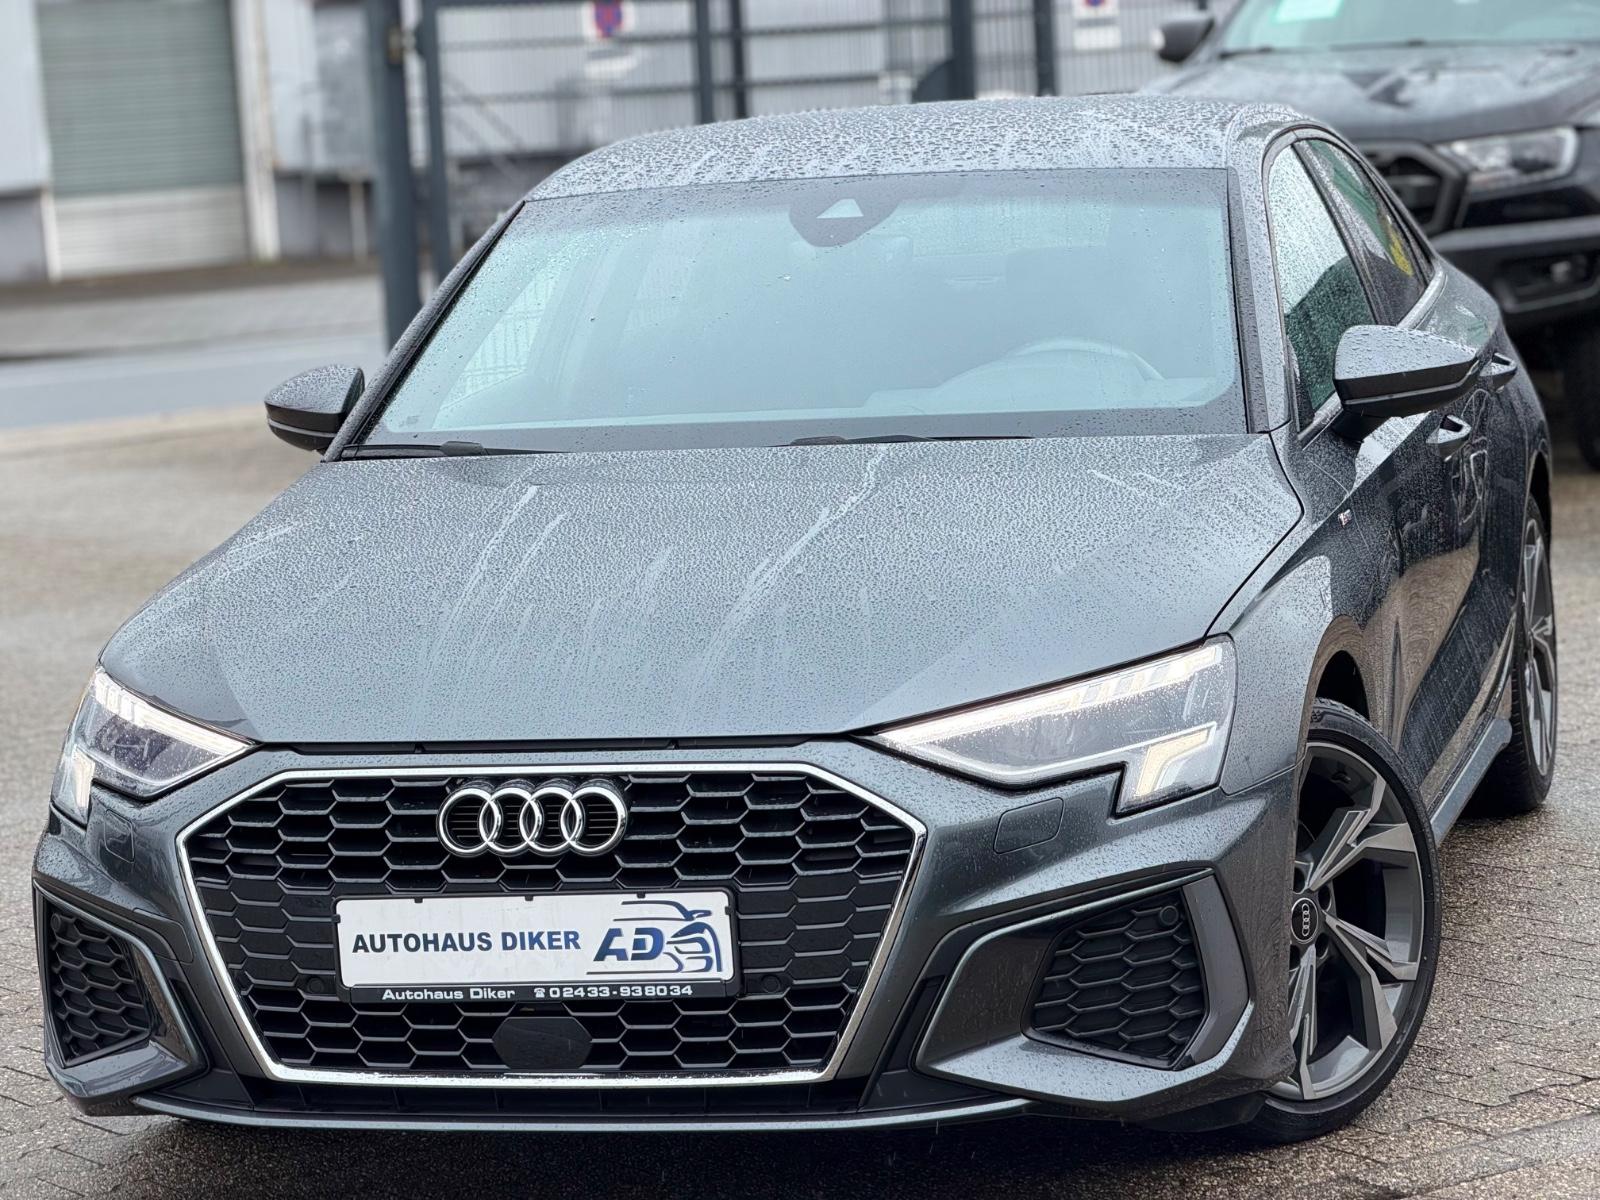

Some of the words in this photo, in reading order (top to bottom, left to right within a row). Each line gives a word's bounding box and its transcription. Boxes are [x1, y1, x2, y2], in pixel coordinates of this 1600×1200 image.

[352, 931, 492, 953] AUTOHAUS
[501, 930, 581, 951] DIKER
[593, 927, 664, 962] AD
[381, 988, 464, 1000] Autohaus
[469, 987, 516, 999] Diker
